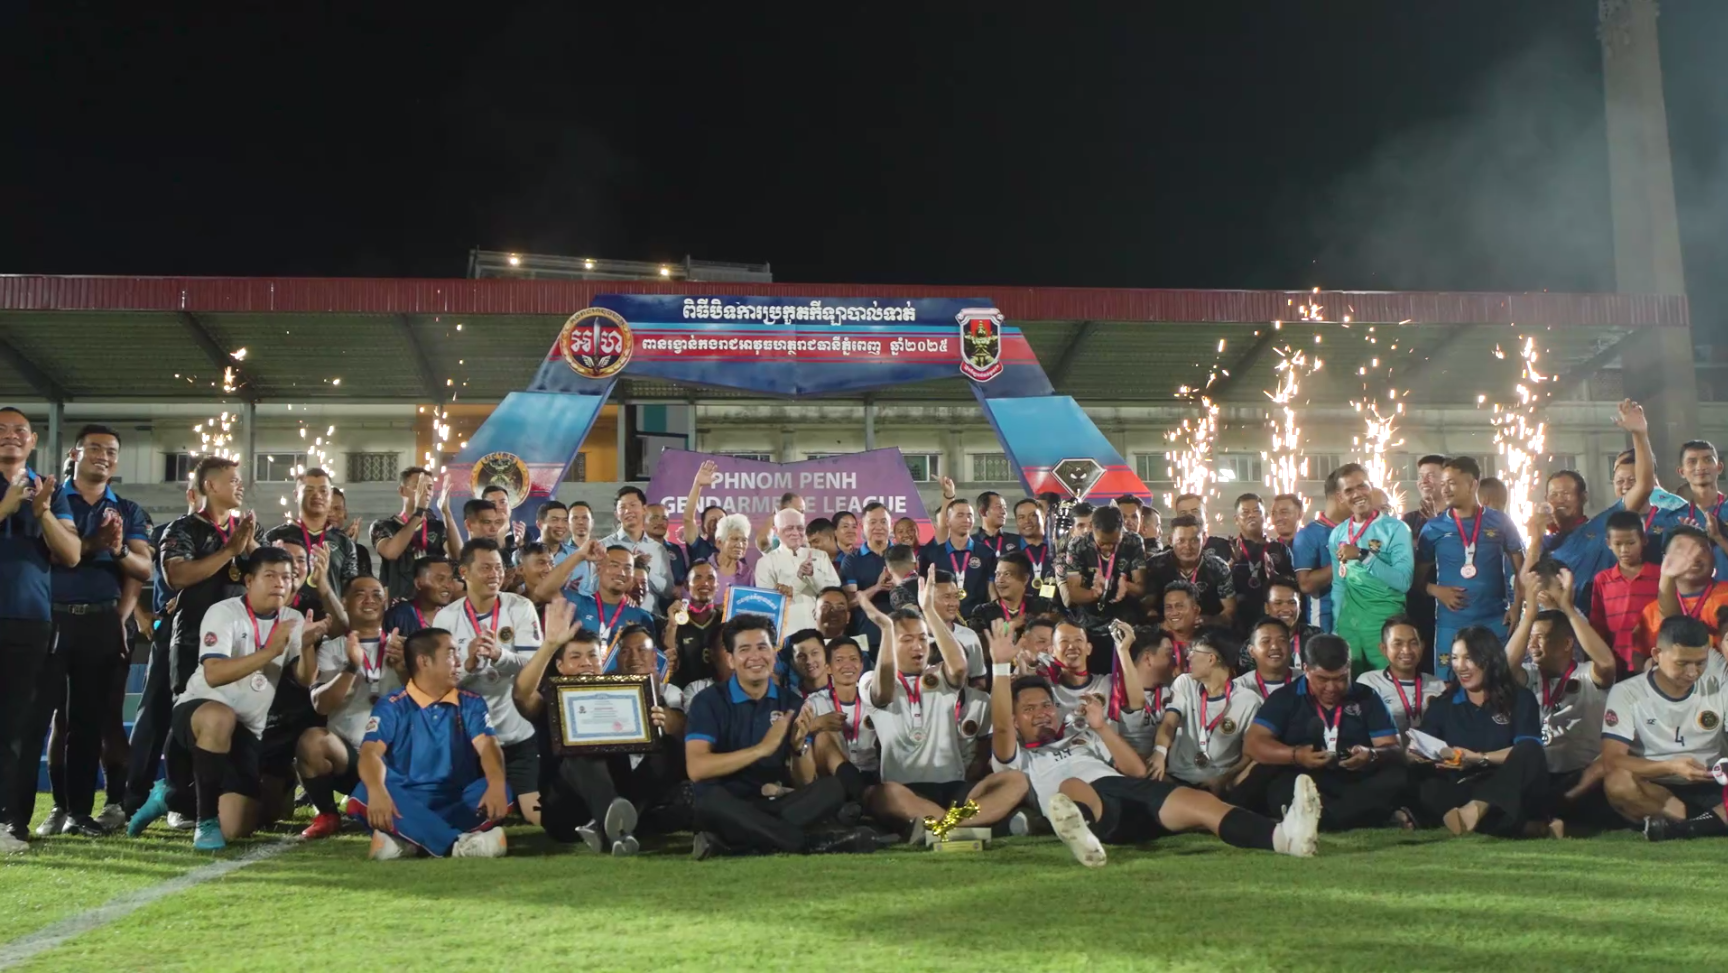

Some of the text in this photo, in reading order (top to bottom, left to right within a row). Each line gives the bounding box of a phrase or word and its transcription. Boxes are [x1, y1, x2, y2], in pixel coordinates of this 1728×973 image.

[711, 472, 857, 489] PHNOM PENH
[660, 496, 816, 514] GENDARMEE
[1675, 726, 1685, 747] 4
